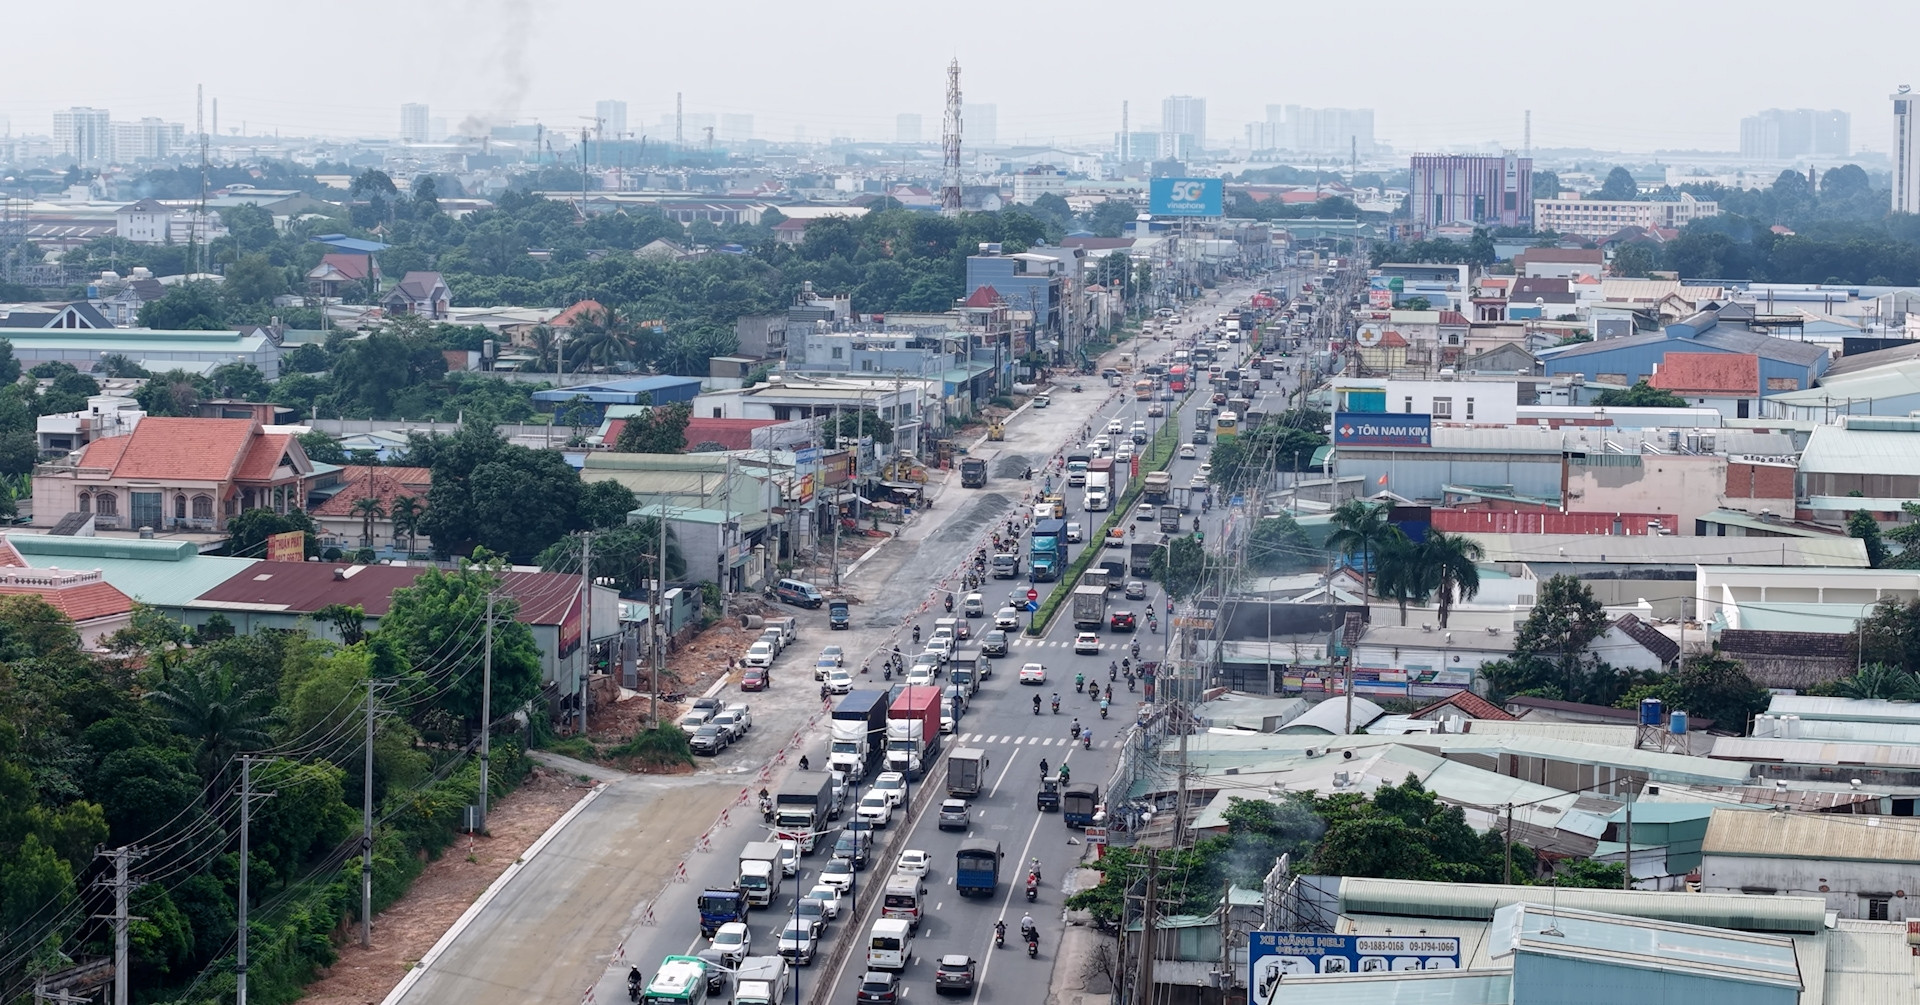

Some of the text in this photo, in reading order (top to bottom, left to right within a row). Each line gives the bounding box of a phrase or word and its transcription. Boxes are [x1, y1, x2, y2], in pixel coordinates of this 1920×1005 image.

[1170, 181, 1205, 201] 5G
[1166, 201, 1206, 210] vinaphone
[1357, 423, 1428, 436] TÔN NAM KIM
[1259, 935, 1275, 945] XE
[1317, 937, 1345, 947] HELI
